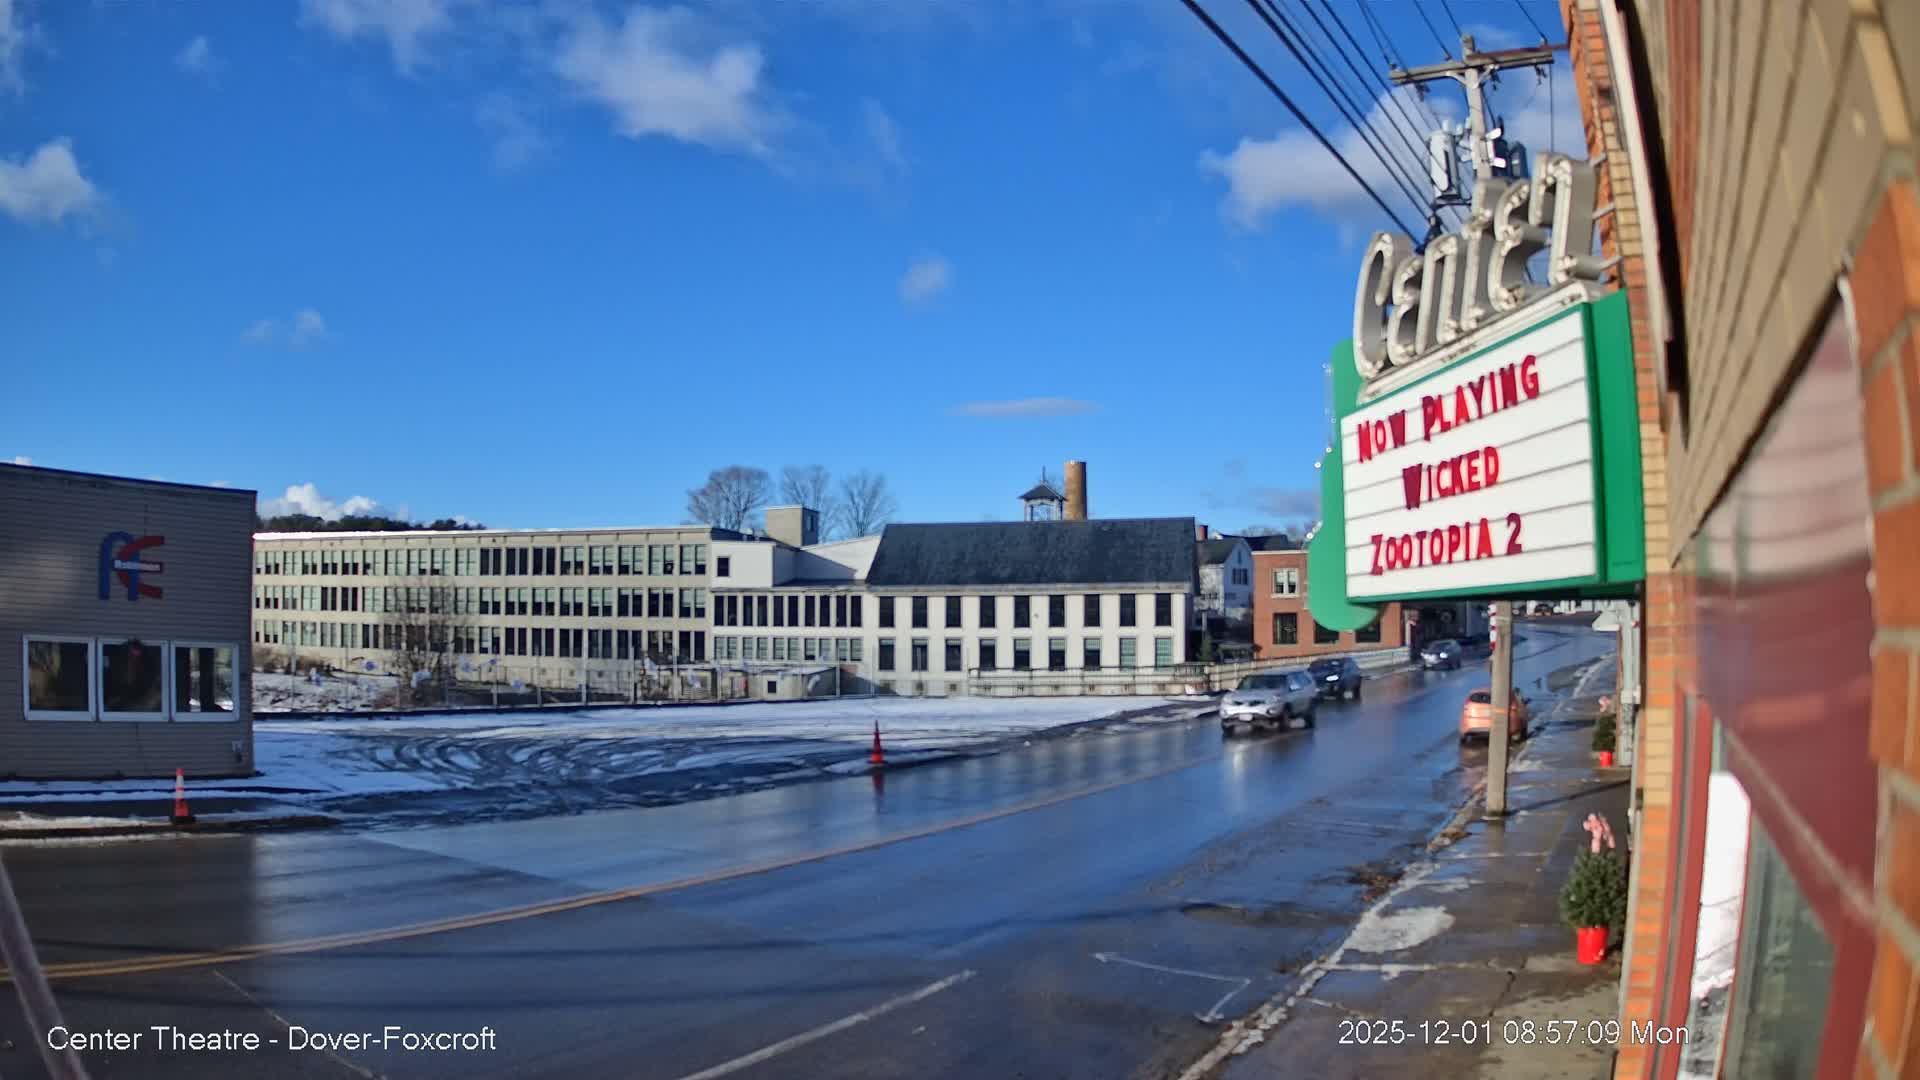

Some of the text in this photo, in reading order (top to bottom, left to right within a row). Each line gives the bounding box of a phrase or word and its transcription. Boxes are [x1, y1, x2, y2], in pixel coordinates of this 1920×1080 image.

[1357, 354, 1540, 463] NOW PLAYING
[1402, 446, 1500, 510] WICKED
[1370, 512, 1523, 576] ZOOTOPIA 2
